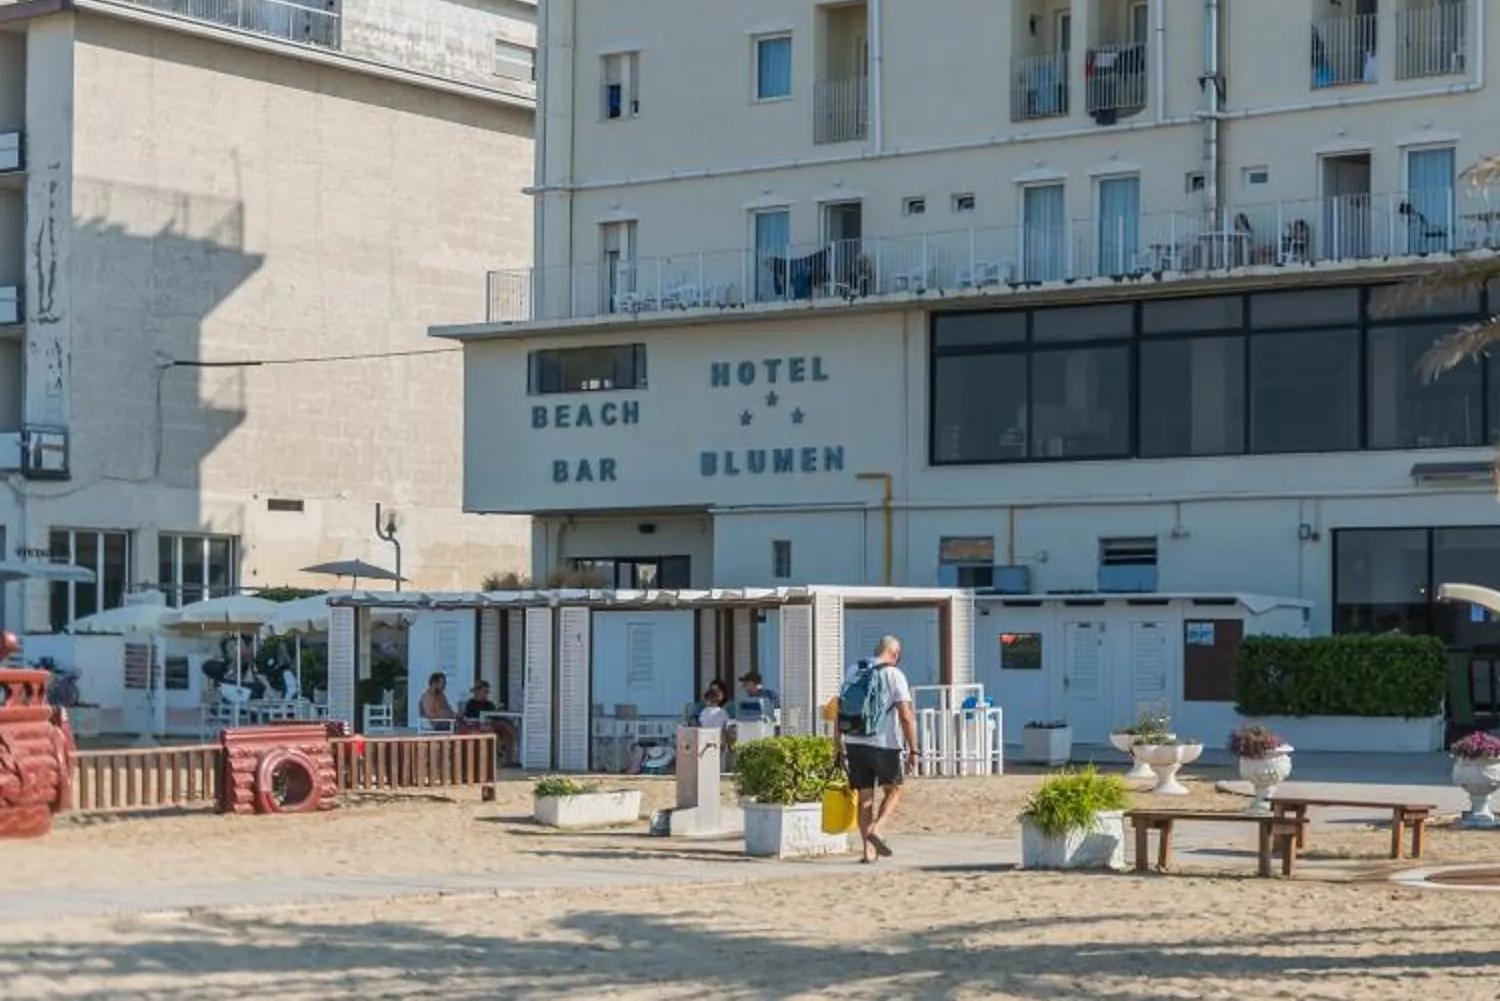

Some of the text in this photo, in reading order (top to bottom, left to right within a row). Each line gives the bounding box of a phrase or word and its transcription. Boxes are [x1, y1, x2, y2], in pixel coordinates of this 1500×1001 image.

[710, 355, 830, 388] HOTEL
[531, 400, 640, 429] BEACH
[552, 457, 618, 483] BAR
[700, 445, 845, 477] BLUMEN
